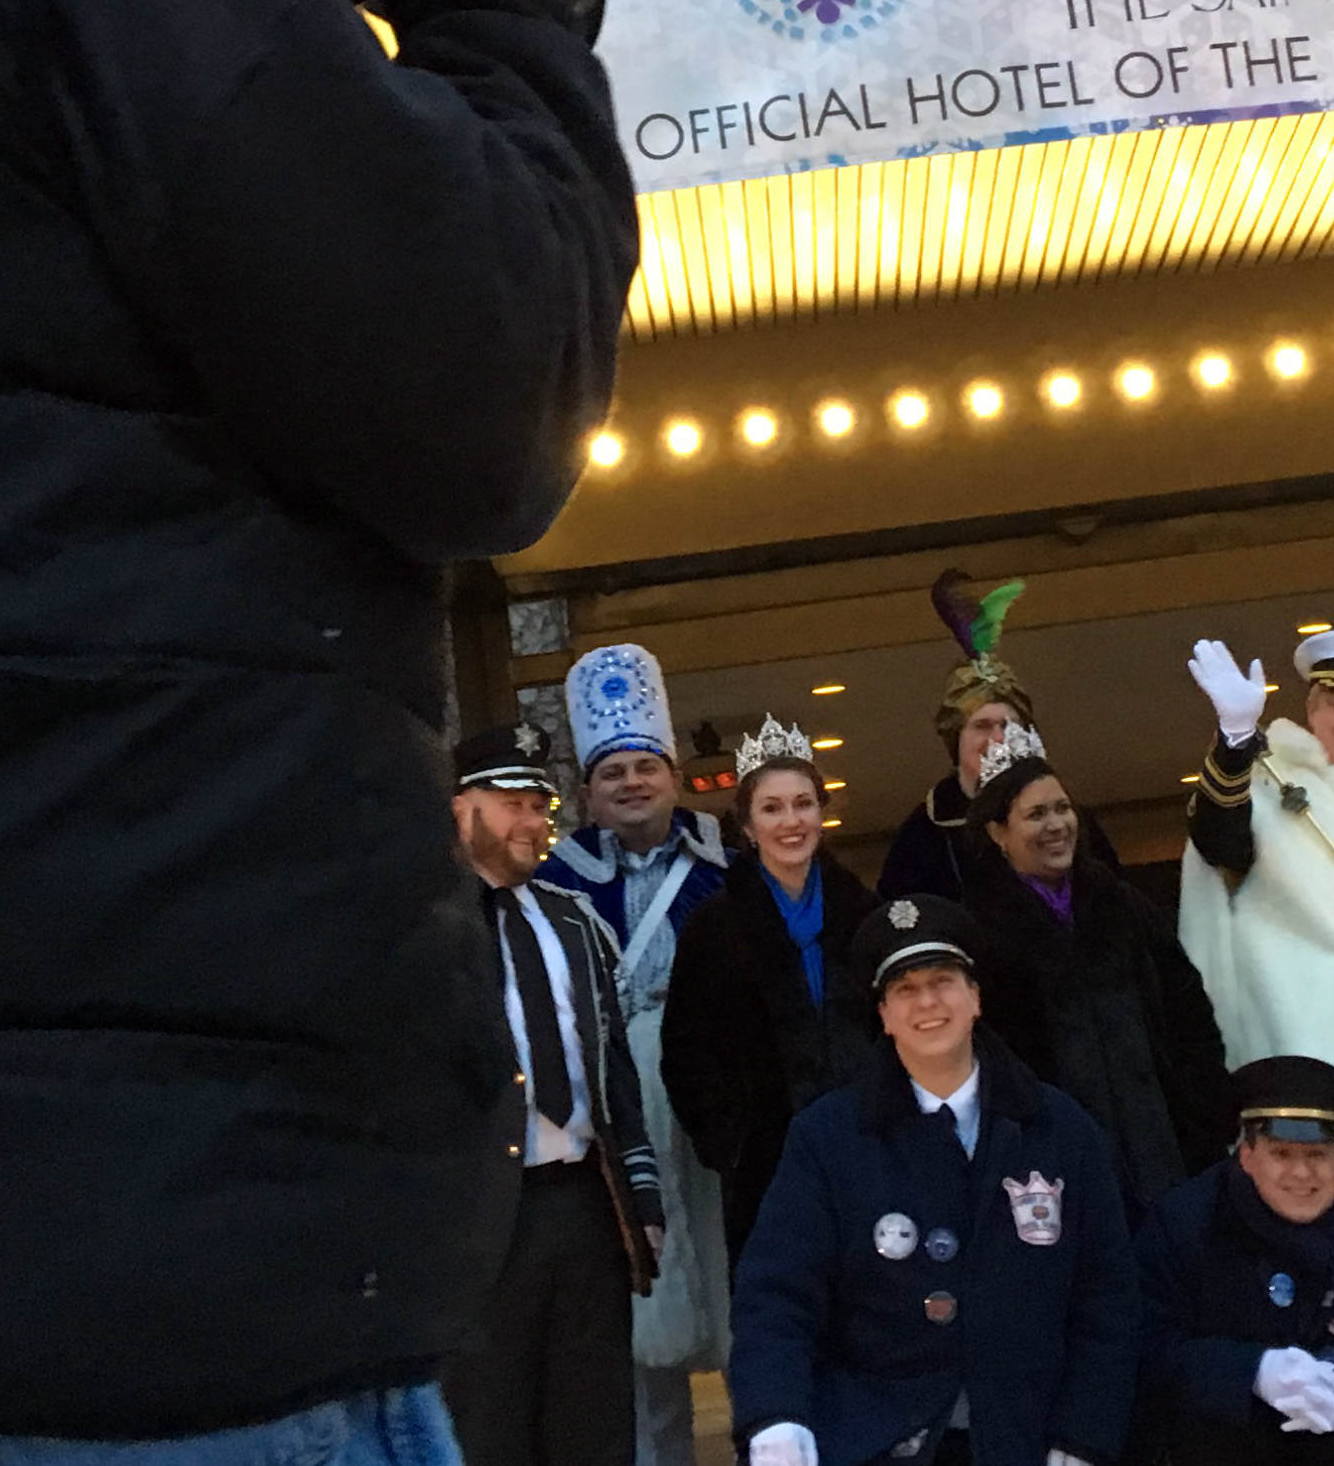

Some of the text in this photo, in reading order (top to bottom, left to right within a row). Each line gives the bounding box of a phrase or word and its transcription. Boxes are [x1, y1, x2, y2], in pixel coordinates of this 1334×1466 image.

[635, 84, 887, 161] OFFICIAL
[907, 60, 1094, 126] HOTEL
[1114, 45, 1190, 100] OF
[1209, 35, 1317, 89] THE
